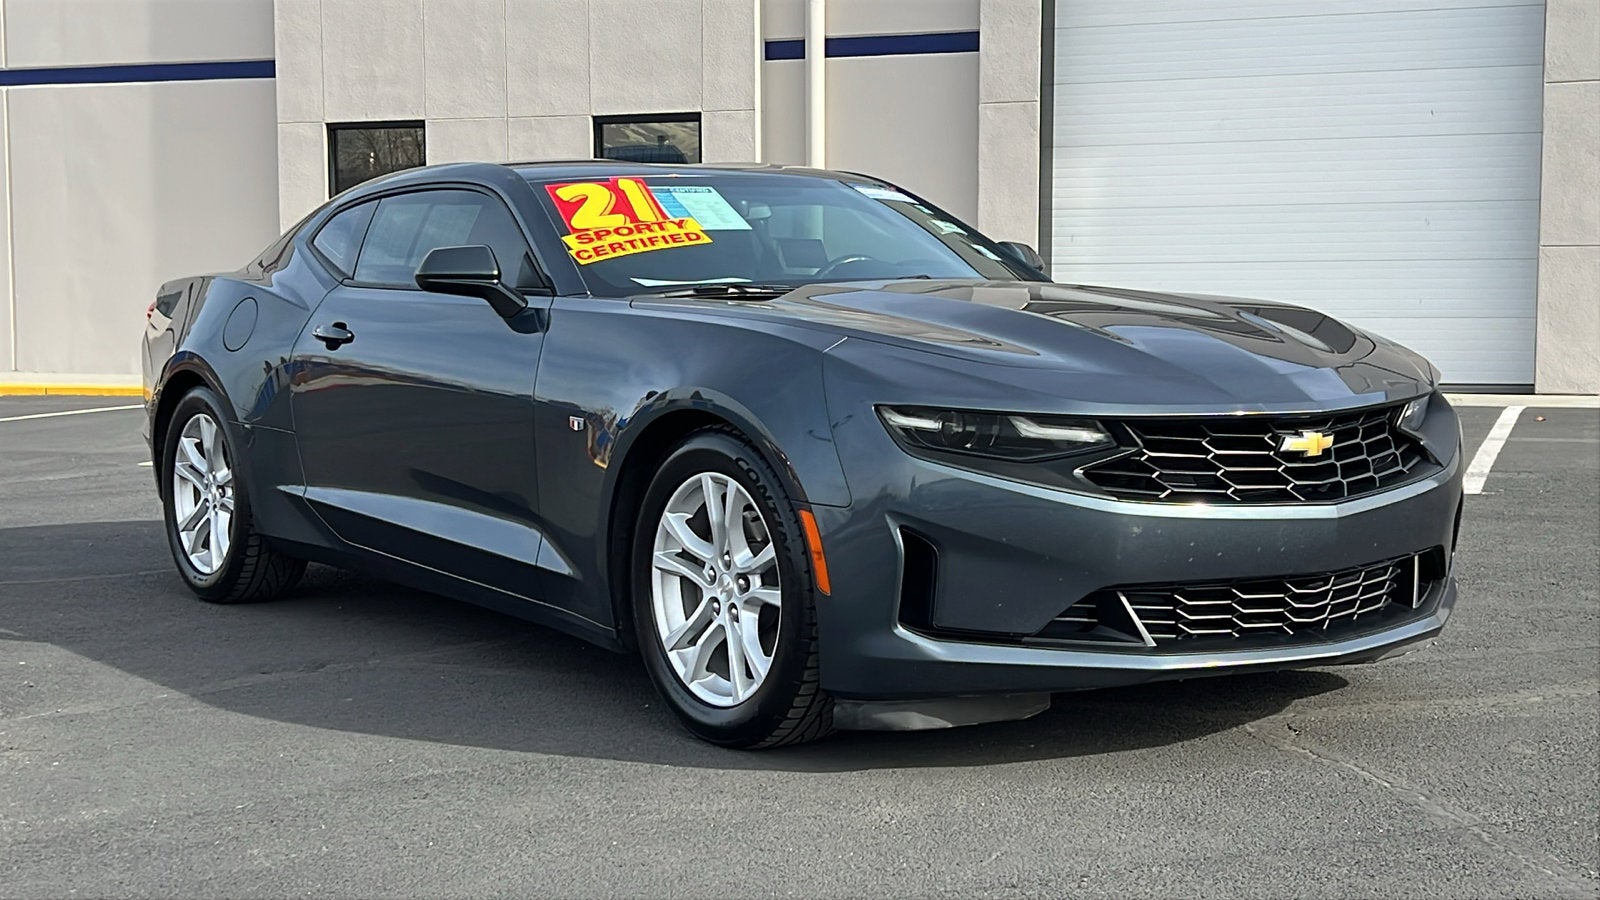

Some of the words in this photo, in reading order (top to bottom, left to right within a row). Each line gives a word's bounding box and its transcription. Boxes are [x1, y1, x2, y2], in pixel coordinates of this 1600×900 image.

[555, 178, 660, 230] 21
[575, 219, 688, 244] SPORTY
[575, 232, 702, 261] CERTIFIED
